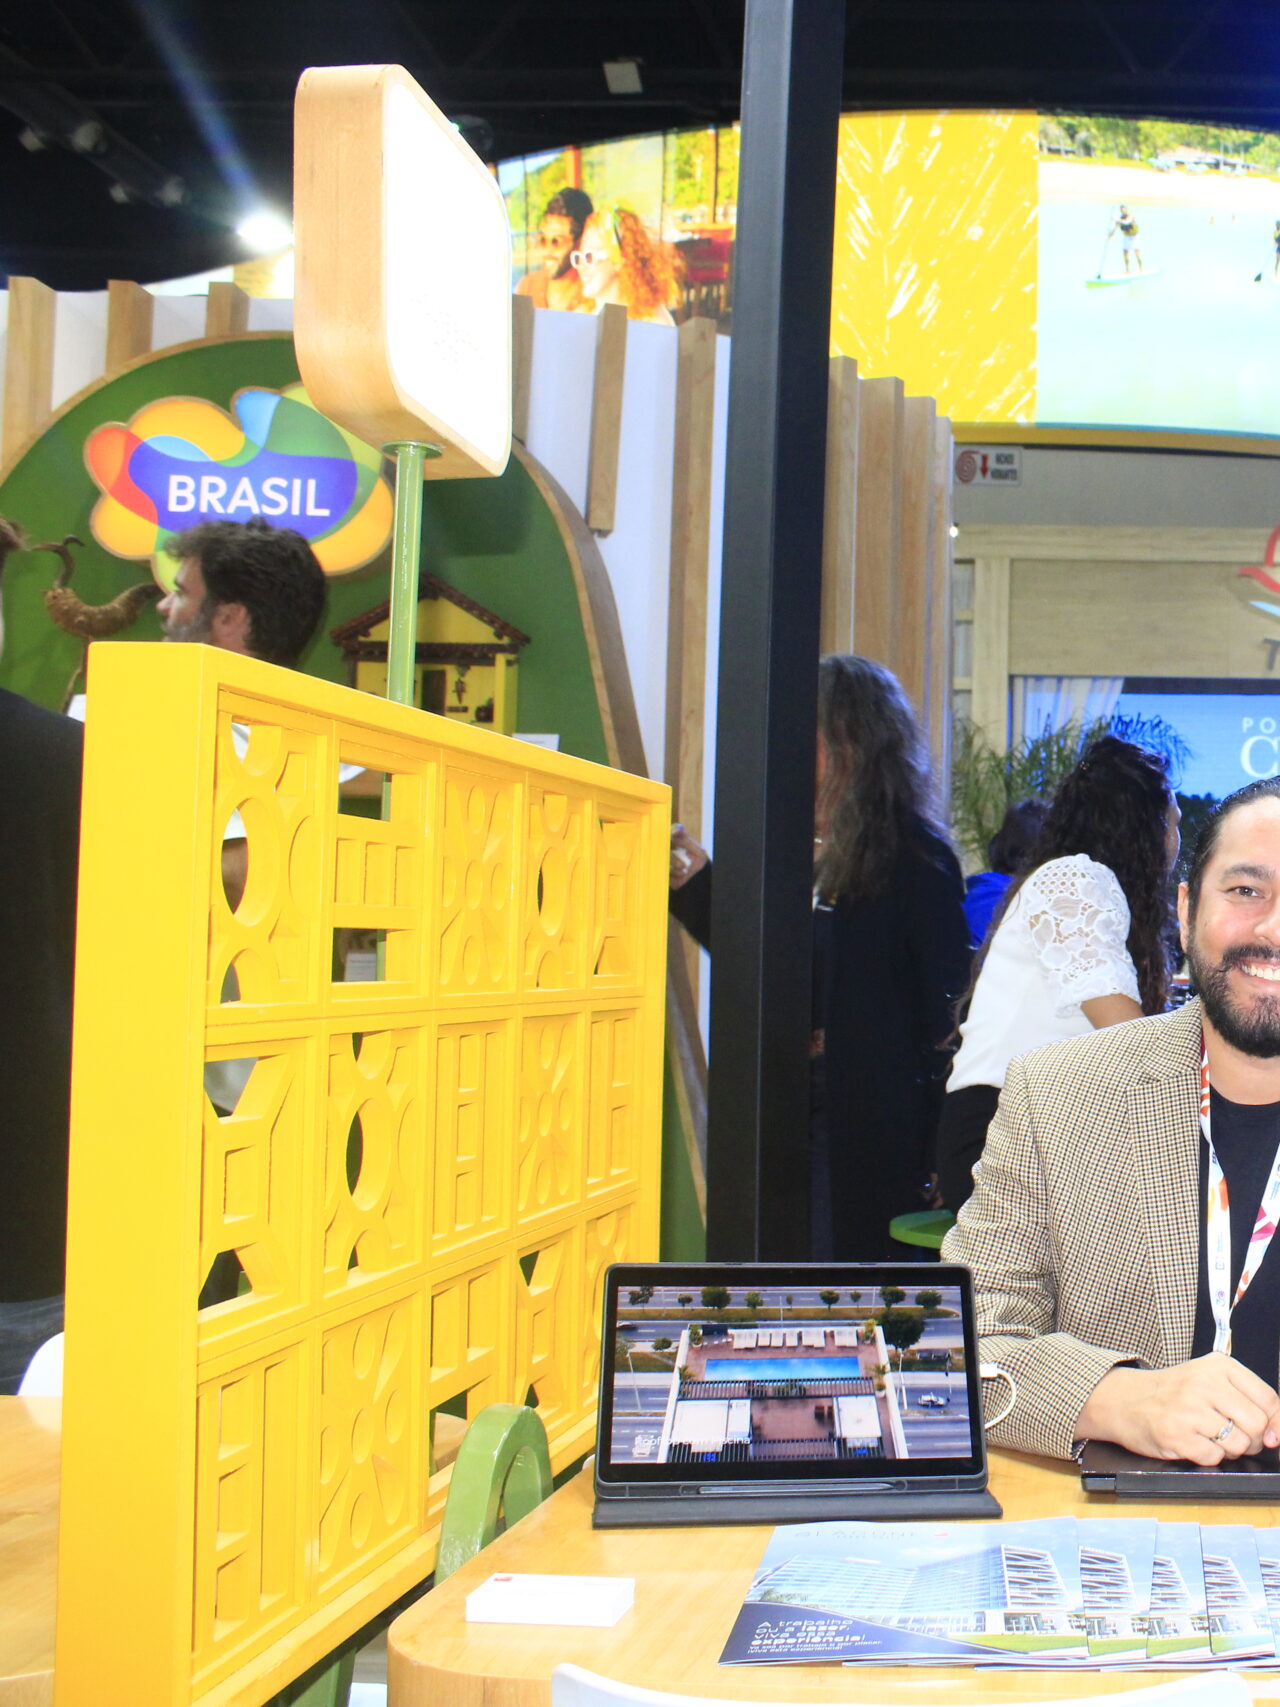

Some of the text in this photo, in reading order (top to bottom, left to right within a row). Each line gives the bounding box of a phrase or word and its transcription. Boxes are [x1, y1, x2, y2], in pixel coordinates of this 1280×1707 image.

[168, 475, 331, 516] BRASIL
[779, 1619, 854, 1628] trabalho
[751, 1634, 866, 1646] experiência!
[755, 1631, 790, 1639] viva
